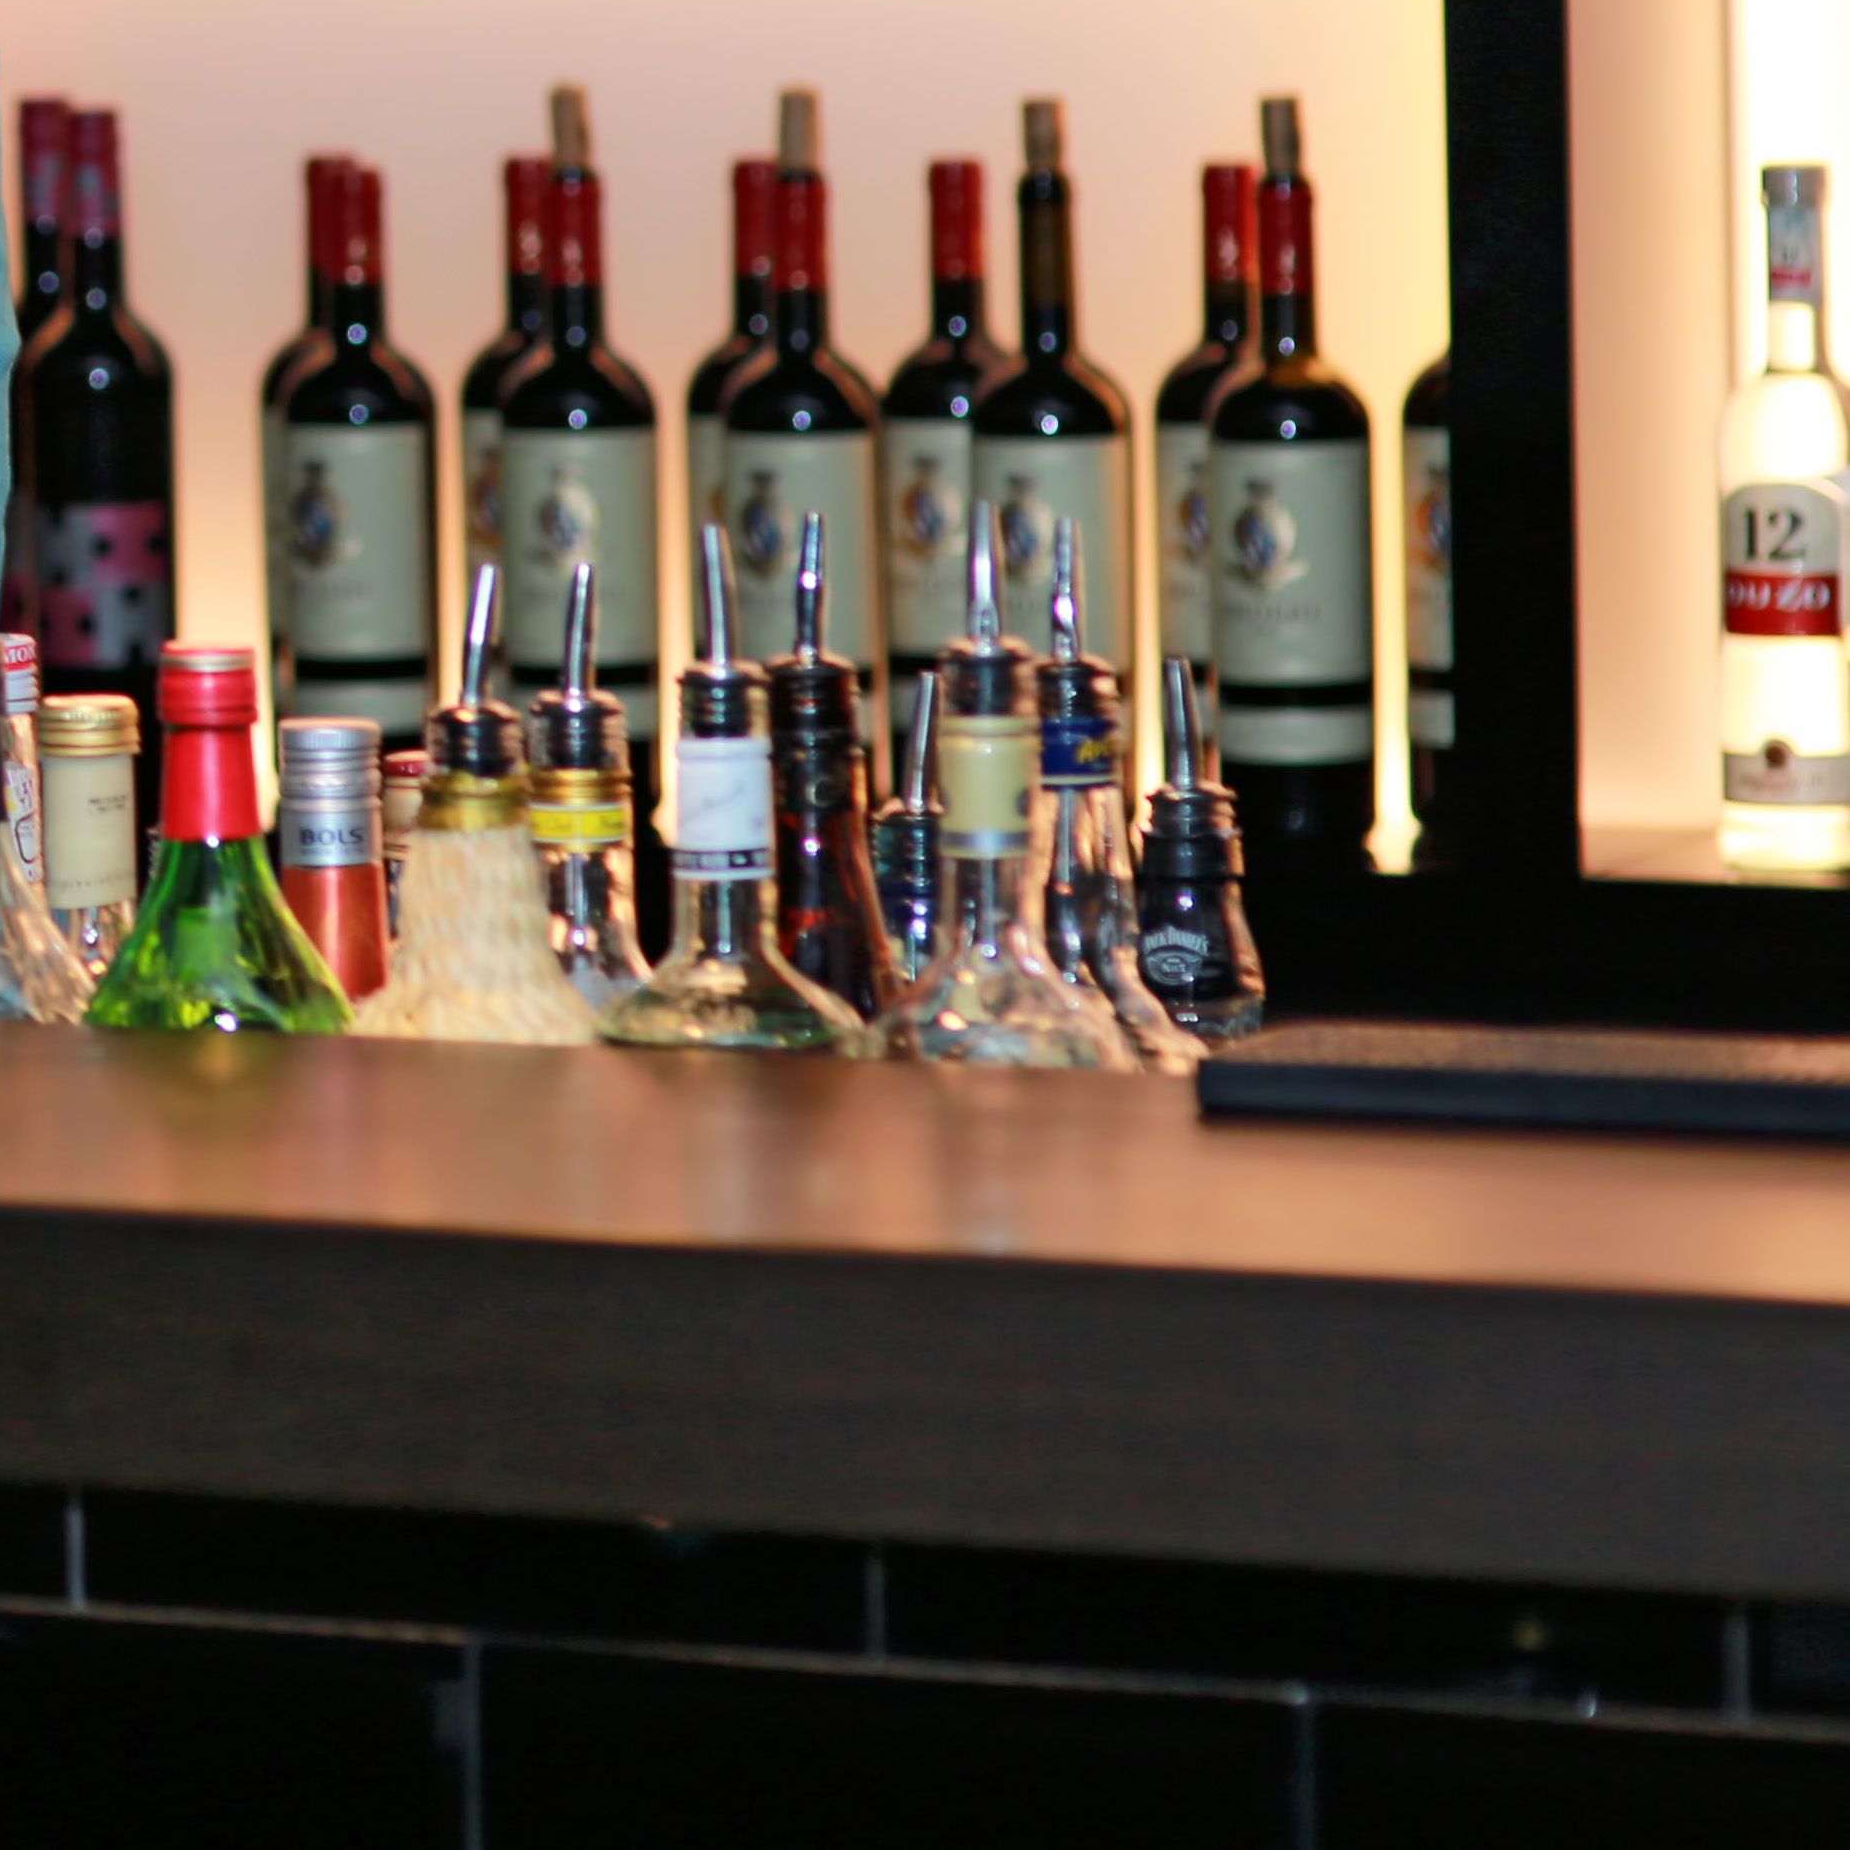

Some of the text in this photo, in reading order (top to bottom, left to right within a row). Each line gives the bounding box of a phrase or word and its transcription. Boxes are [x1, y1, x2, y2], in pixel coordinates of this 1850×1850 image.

[1743, 505, 1807, 562] 12
[1725, 577, 1831, 613] OUZO
[300, 827, 365, 845] BOLS
